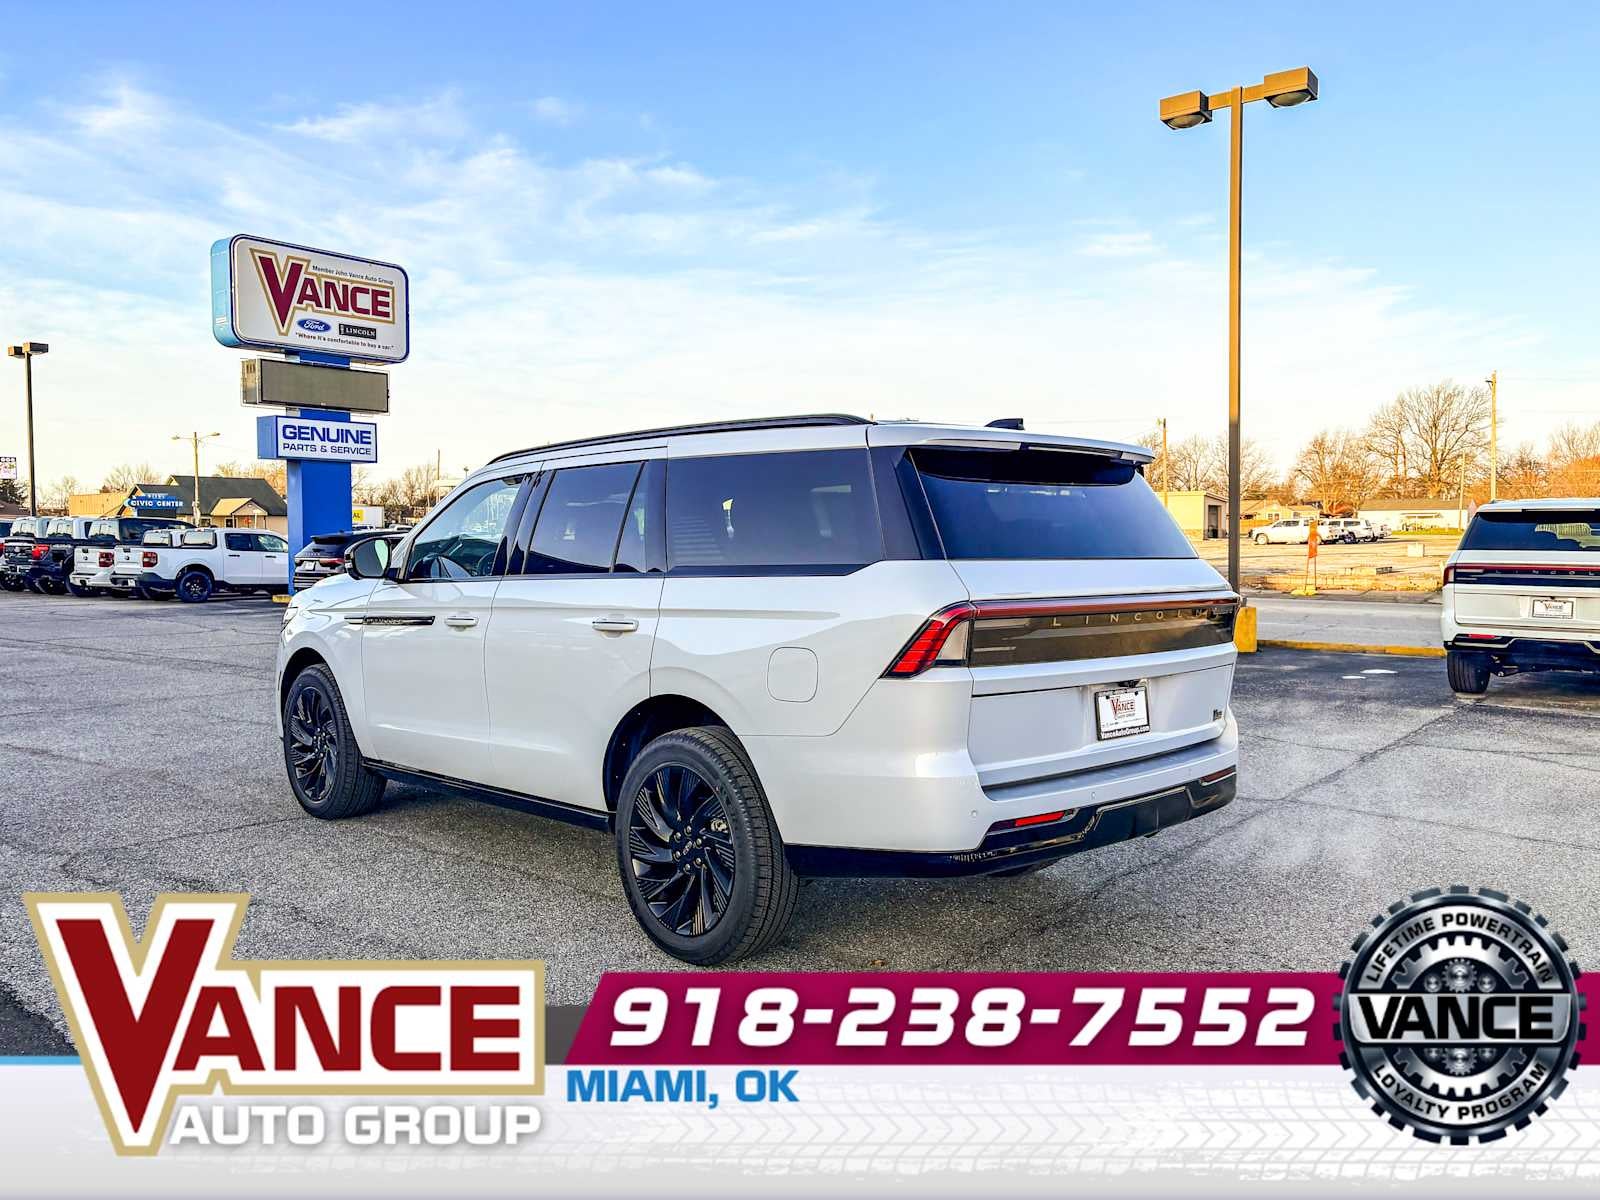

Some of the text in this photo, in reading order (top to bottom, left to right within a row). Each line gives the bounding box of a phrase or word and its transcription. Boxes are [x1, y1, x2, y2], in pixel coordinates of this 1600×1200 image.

[349, 271, 364, 279] Vance
[258, 254, 391, 329] VANCE
[303, 319, 325, 331] Ford
[345, 326, 376, 337] LINCOLN
[282, 424, 372, 445] GENUINE
[283, 442, 372, 456] PARTS & SERVICE
[1052, 609, 1208, 627] LINCOLN
[1110, 698, 1135, 717] VANCE
